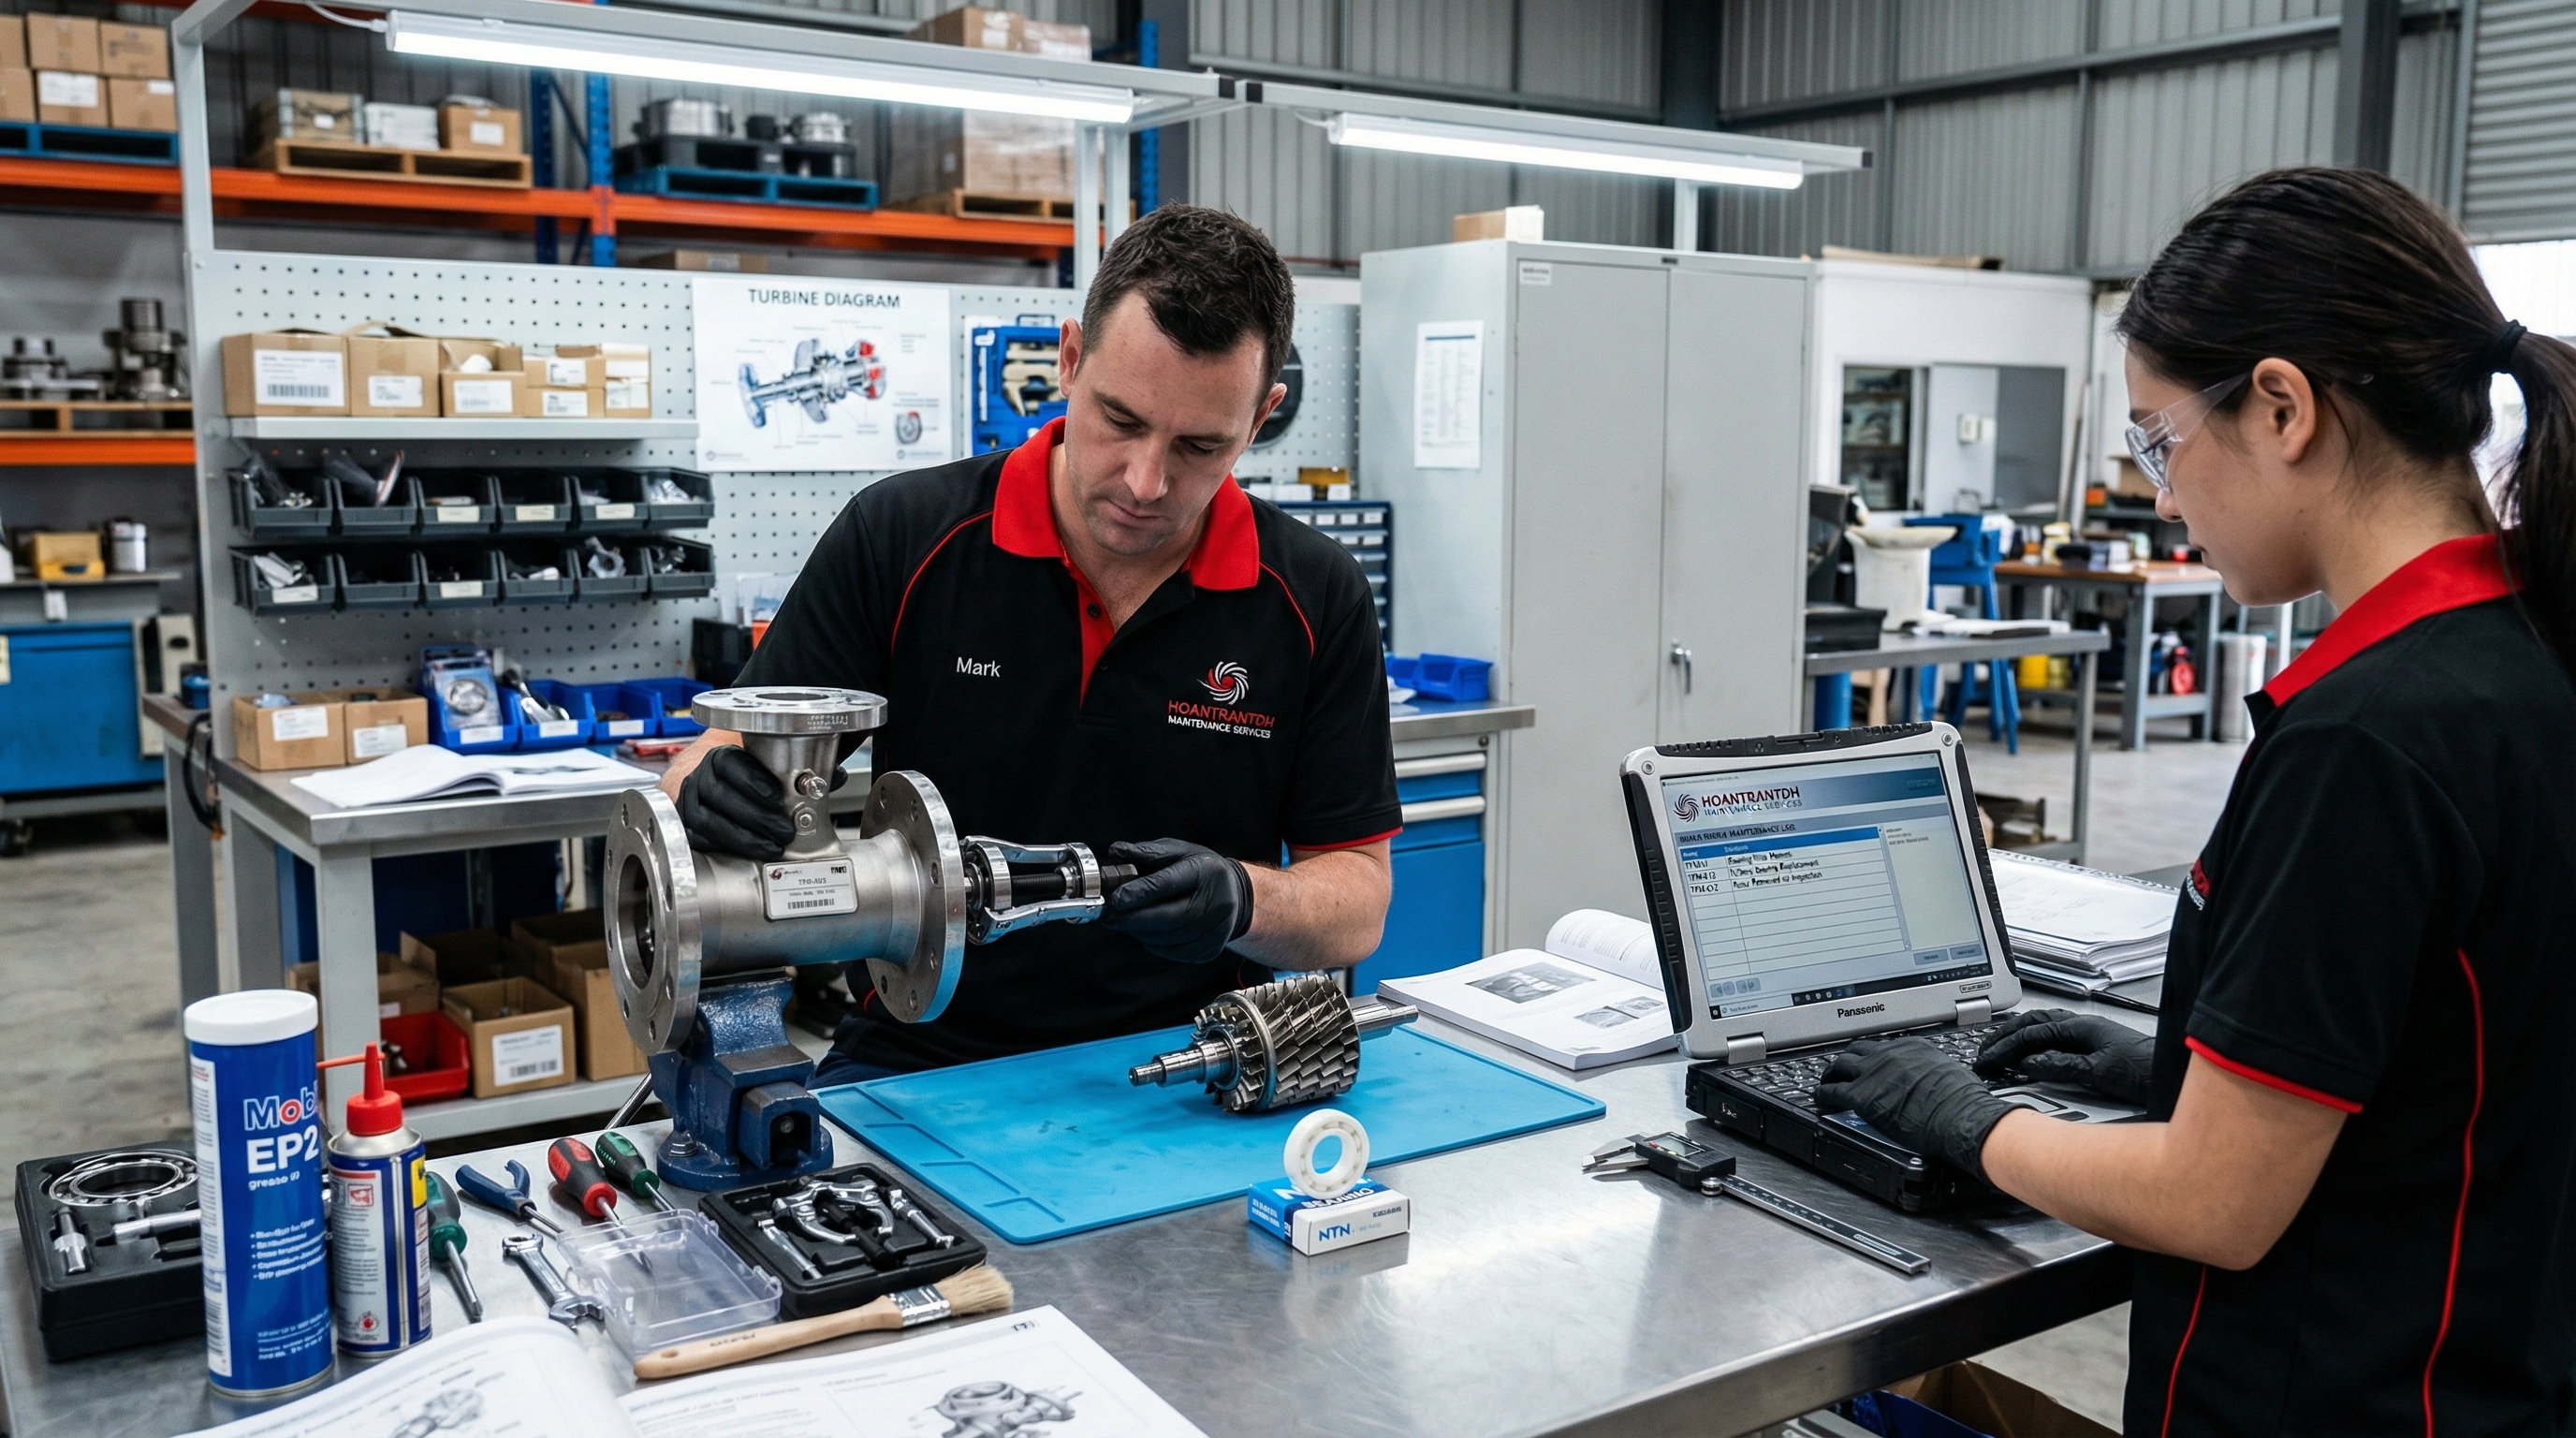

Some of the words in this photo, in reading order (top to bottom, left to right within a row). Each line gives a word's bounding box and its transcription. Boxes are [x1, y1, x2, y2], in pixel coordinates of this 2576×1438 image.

[749, 288, 819, 306] TURBINE
[825, 292, 900, 308] DIAGRAM
[957, 657, 1001, 678] Mark
[1167, 699, 1275, 728] HOANTRANTDH
[1702, 786, 1800, 808] HOANTRANTDH
[246, 1124, 318, 1174] EP2
[1319, 1223, 1351, 1241] NTN
